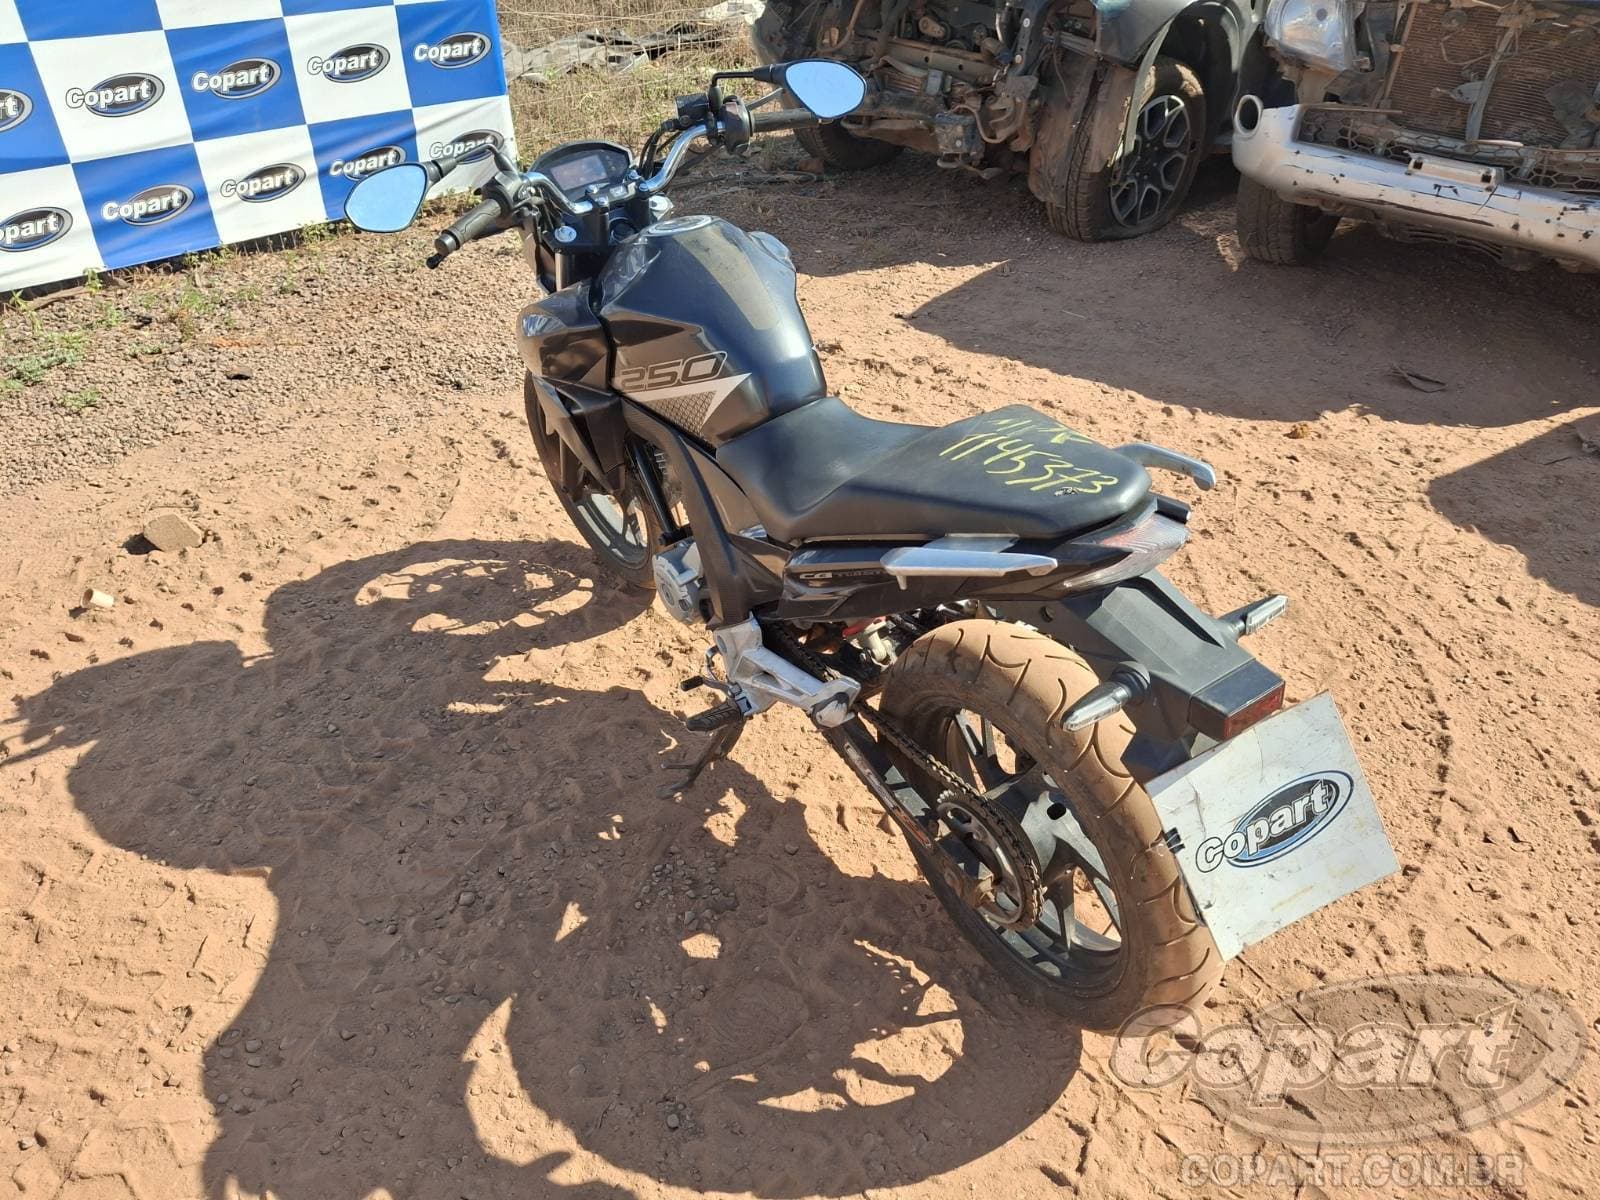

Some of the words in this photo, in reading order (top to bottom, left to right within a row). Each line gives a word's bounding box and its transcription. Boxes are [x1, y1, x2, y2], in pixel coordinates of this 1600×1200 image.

[307, 49, 381, 77] Copart
[414, 36, 482, 62] Copart
[191, 61, 271, 92] Copart
[65, 78, 152, 109] Copart
[328, 149, 398, 177] Copart
[219, 169, 297, 198] Copart
[101, 189, 185, 221] Copart
[620, 350, 728, 391] 250
[1195, 778, 1331, 874] Copart
